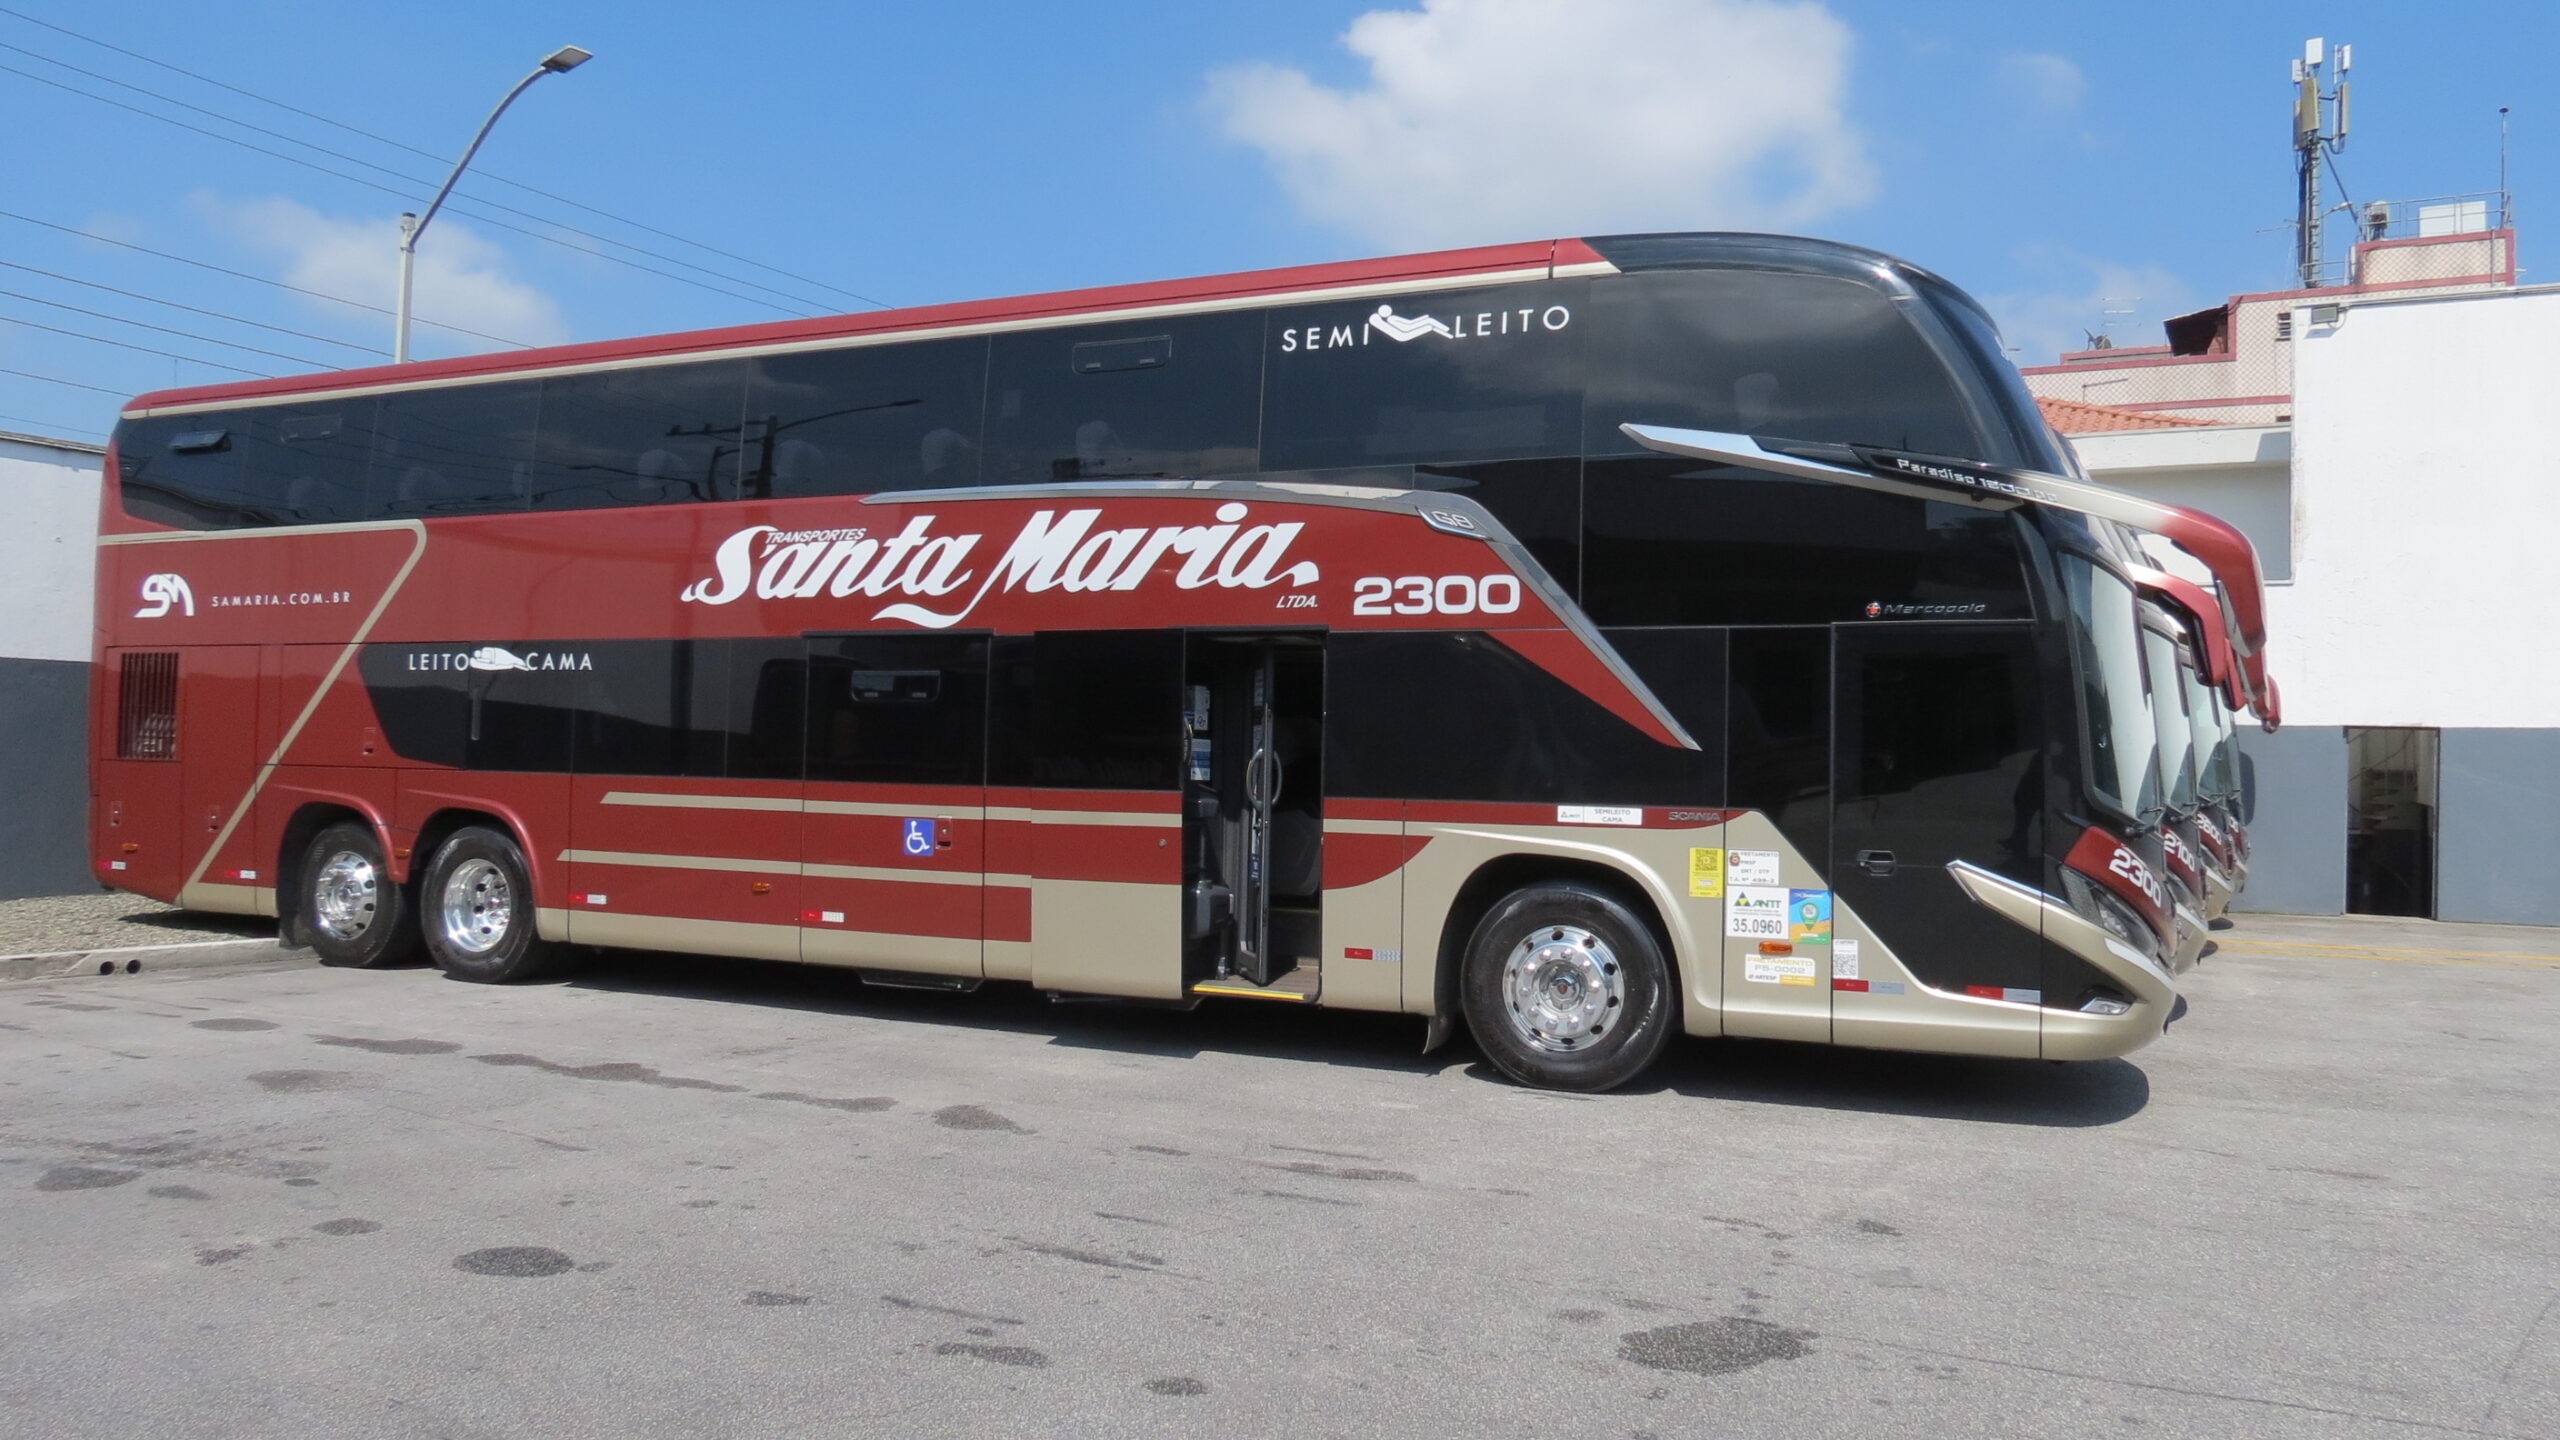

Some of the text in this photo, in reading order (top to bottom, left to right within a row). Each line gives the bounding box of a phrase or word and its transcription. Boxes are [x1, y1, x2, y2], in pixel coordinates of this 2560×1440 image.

[1281, 305, 1570, 352] SEMI LEITO
[1896, 458, 1976, 485] Paradiso
[1431, 510, 1475, 530] G8
[765, 527, 868, 544] TRANSPORTES
[681, 503, 1320, 605] Santa Maria
[211, 591, 351, 608] SAMARIA.COM.BR
[1276, 595, 1319, 608] LTDA.
[1353, 574, 1521, 615] 2300
[1884, 603, 1986, 615] Marcopolo
[408, 652, 593, 672] LEITO CAMA
[1594, 808, 1631, 816] SEMILEITO
[1668, 811, 1721, 822] SCANIA
[2164, 832, 2195, 873] 2100
[2108, 848, 2162, 909] 2300
[1752, 899, 1782, 909] ANTT
[1733, 918, 1783, 935] 35.0960
[1747, 957, 1813, 967] FRETAMENTO
